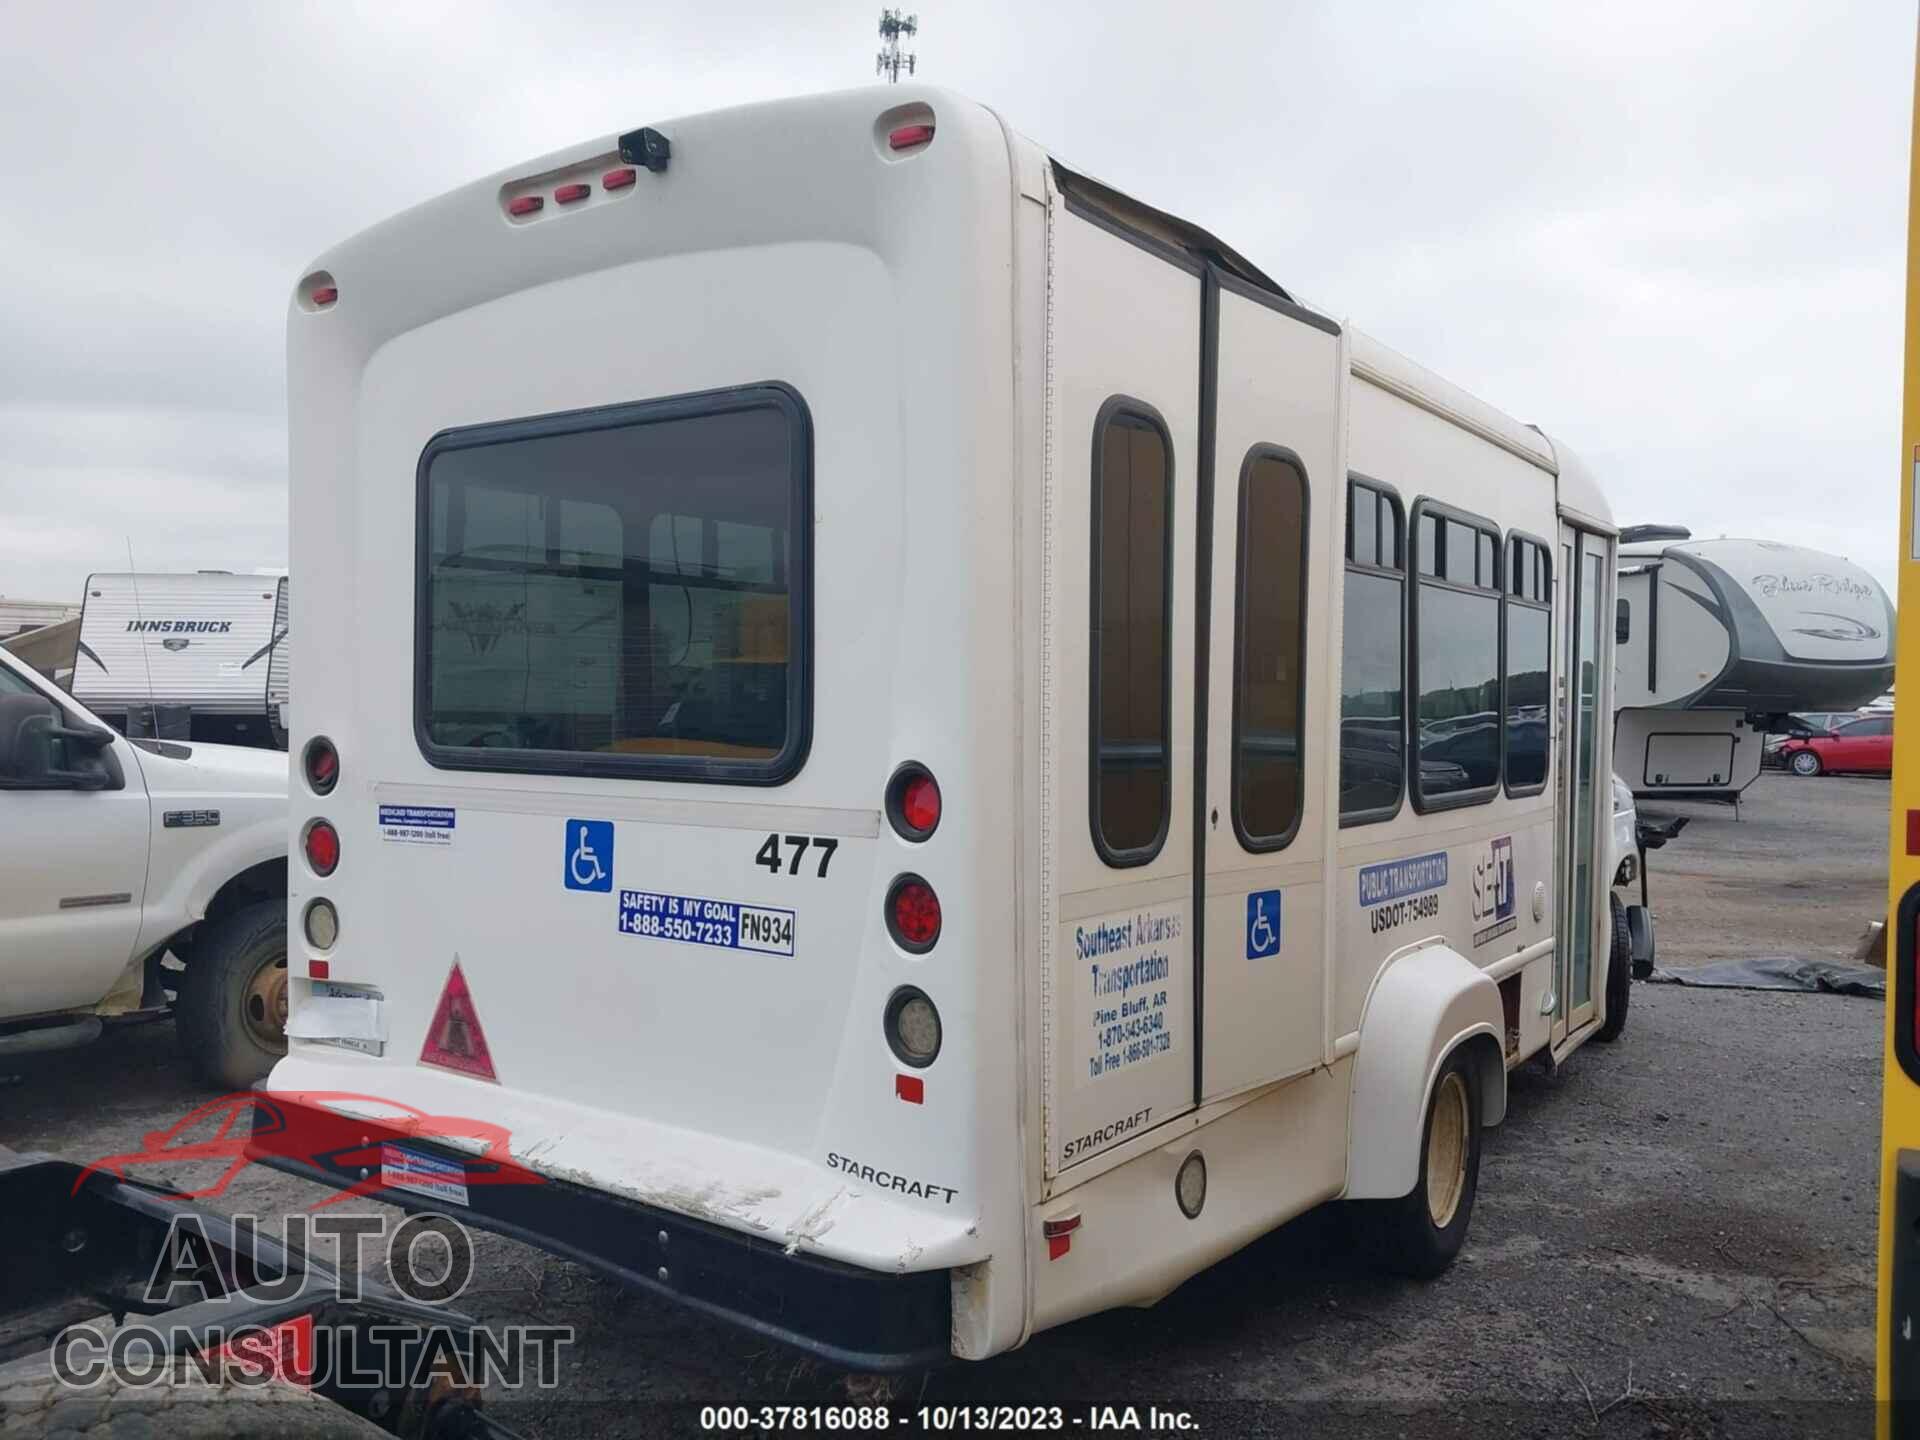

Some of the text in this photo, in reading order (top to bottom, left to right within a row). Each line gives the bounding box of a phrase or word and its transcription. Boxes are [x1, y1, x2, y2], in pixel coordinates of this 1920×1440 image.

[1752, 573, 1873, 599] Blue Ridge
[126, 620, 233, 633] INNSBRUCK
[755, 833, 839, 878] 477
[1361, 857, 1447, 903] PUBLIC TRANSPORTATION
[622, 892, 736, 922] SAFETY IS MY GOAL
[1371, 893, 1439, 934] USDOT-754989
[620, 911, 732, 946] 1-888-550-7233
[741, 912, 792, 946] FN934
[1076, 912, 1182, 960] Southeast Arkansas
[1091, 950, 1169, 999] Transportation
[1093, 991, 1167, 1028] Pine Bluff, AR
[1098, 1012, 1164, 1049] 1-870-543-6340
[1089, 1056, 1103, 1078] Toll
[1104, 1053, 1121, 1072] Free
[1063, 1107, 1153, 1159] STARCRAFT
[826, 1152, 959, 1204] STARCRAFT
